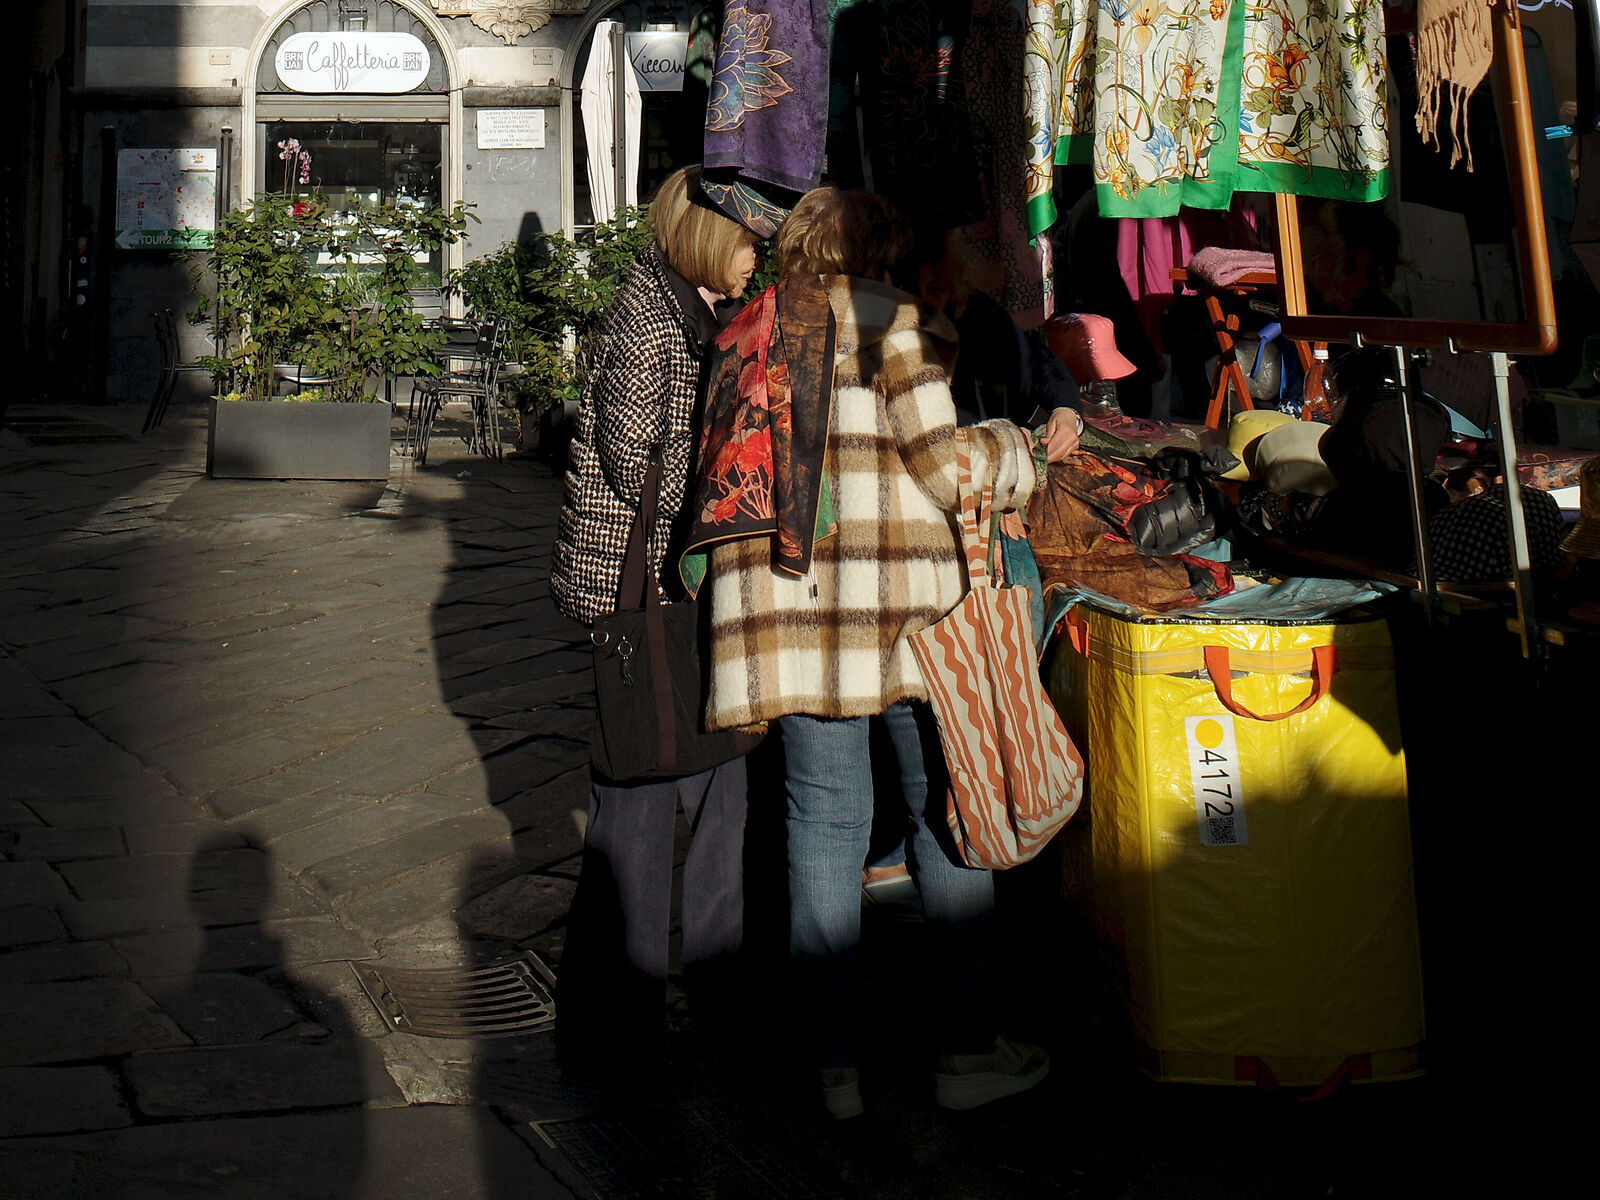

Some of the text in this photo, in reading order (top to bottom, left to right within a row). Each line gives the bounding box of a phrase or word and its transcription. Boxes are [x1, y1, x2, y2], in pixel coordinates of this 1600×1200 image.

[285, 52, 303, 61] BRN
[307, 40, 401, 91] Caffetteria
[403, 53, 421, 62] BRN
[1199, 749, 1235, 818] 4172
